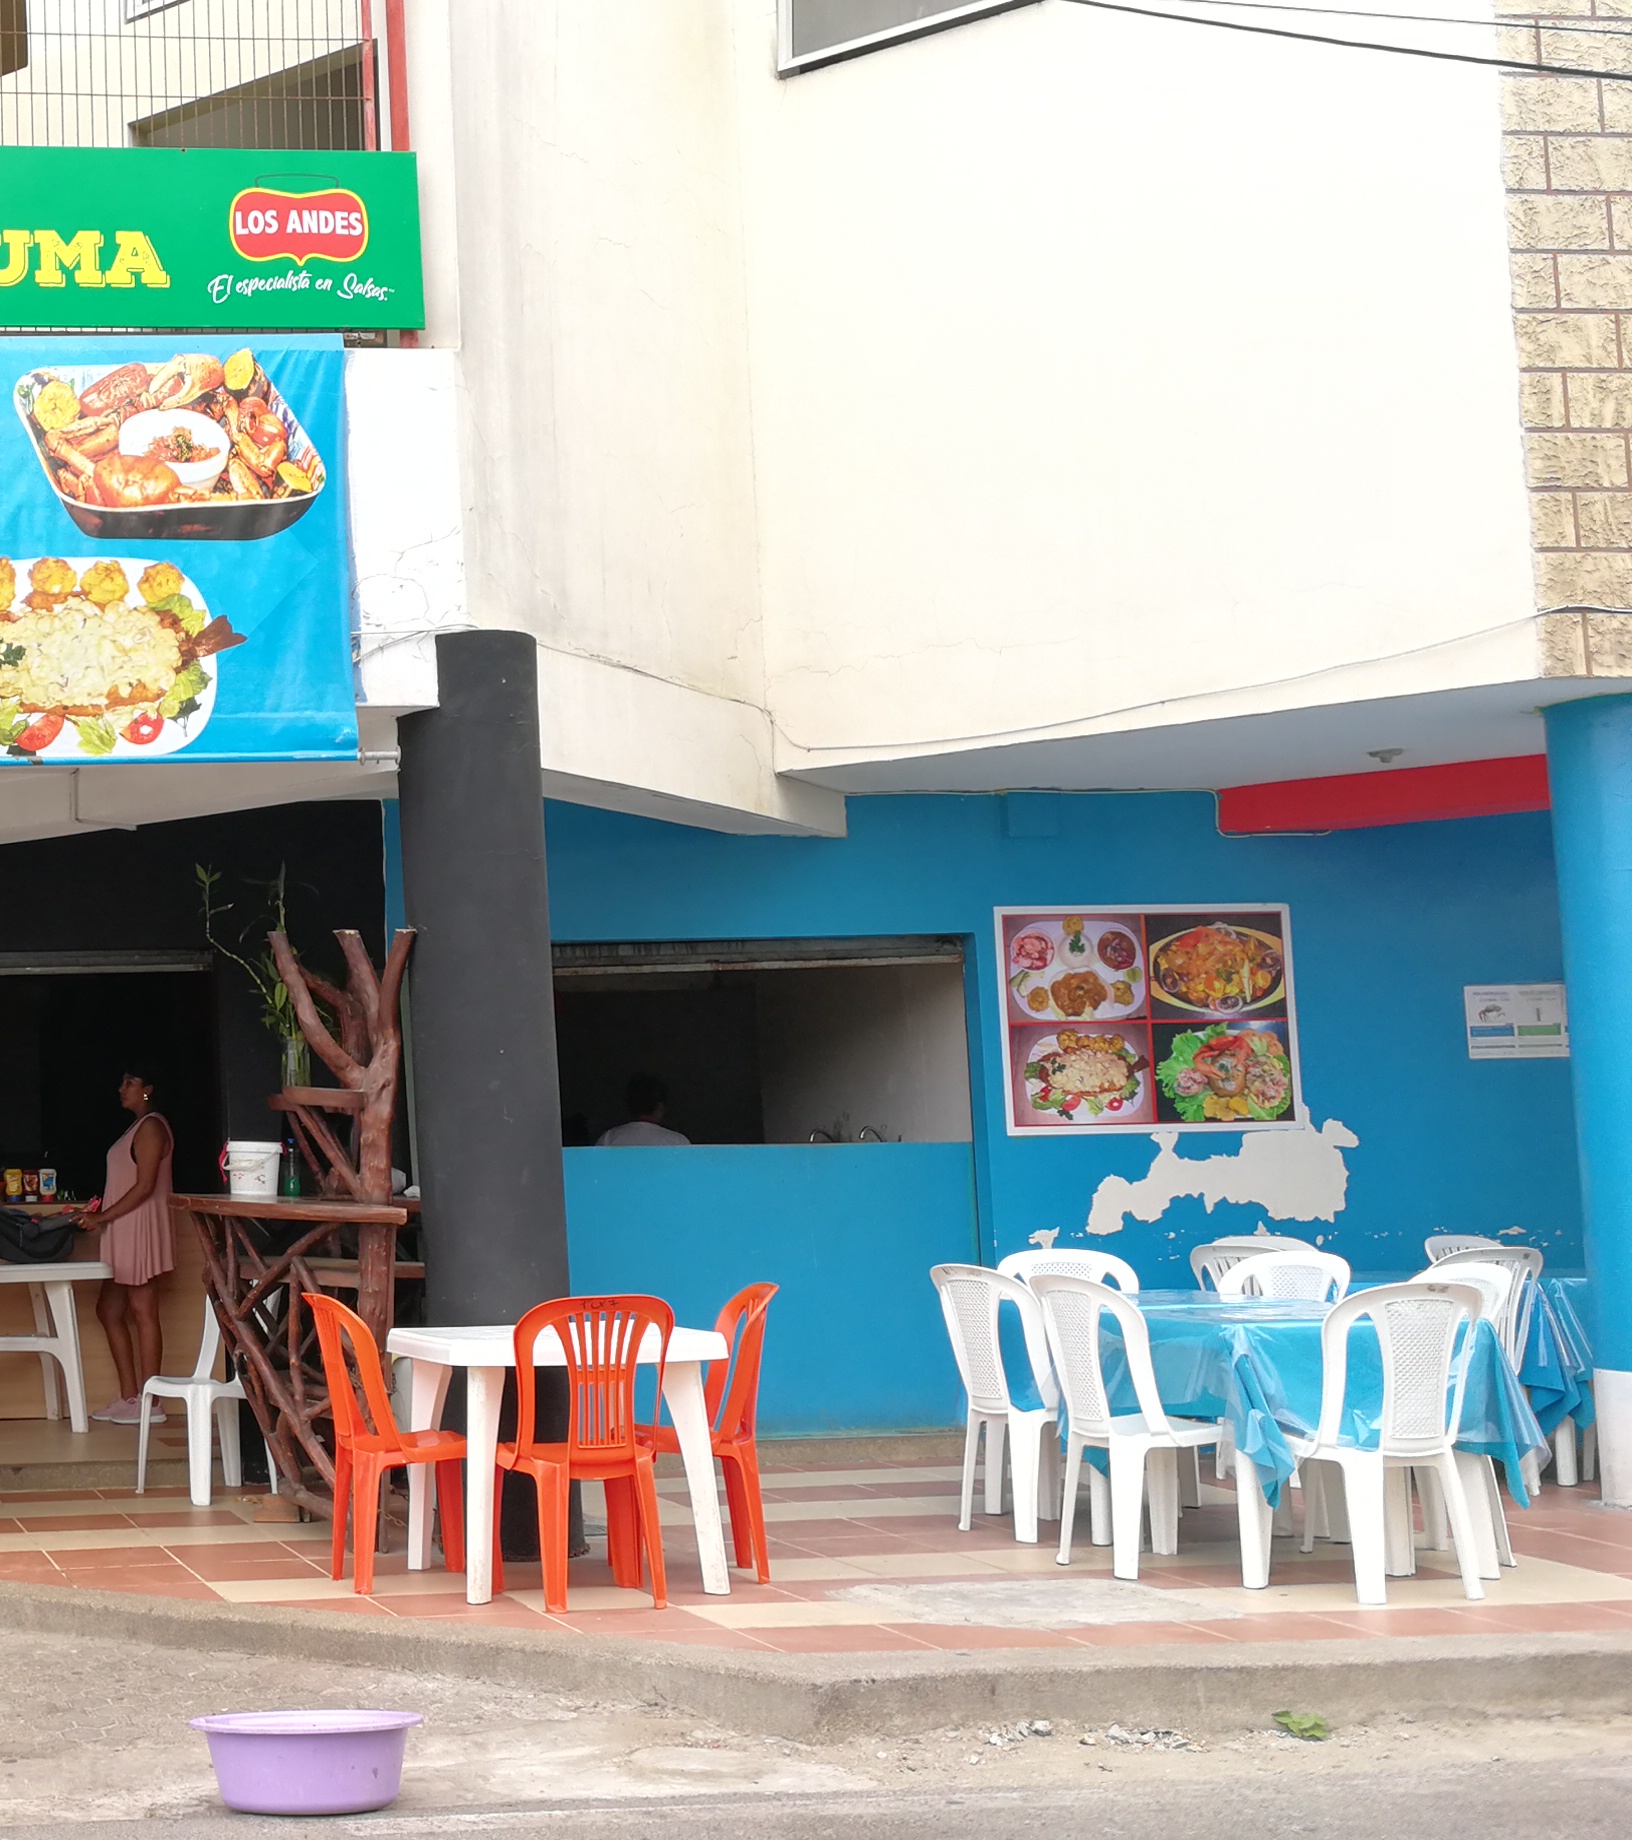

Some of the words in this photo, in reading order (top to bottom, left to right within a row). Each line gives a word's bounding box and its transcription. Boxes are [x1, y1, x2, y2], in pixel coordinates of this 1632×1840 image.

[234, 209, 279, 236] LOS
[286, 209, 363, 237] ANDES
[207, 273, 234, 304] El
[235, 270, 313, 298] especialista
[315, 277, 334, 292] en
